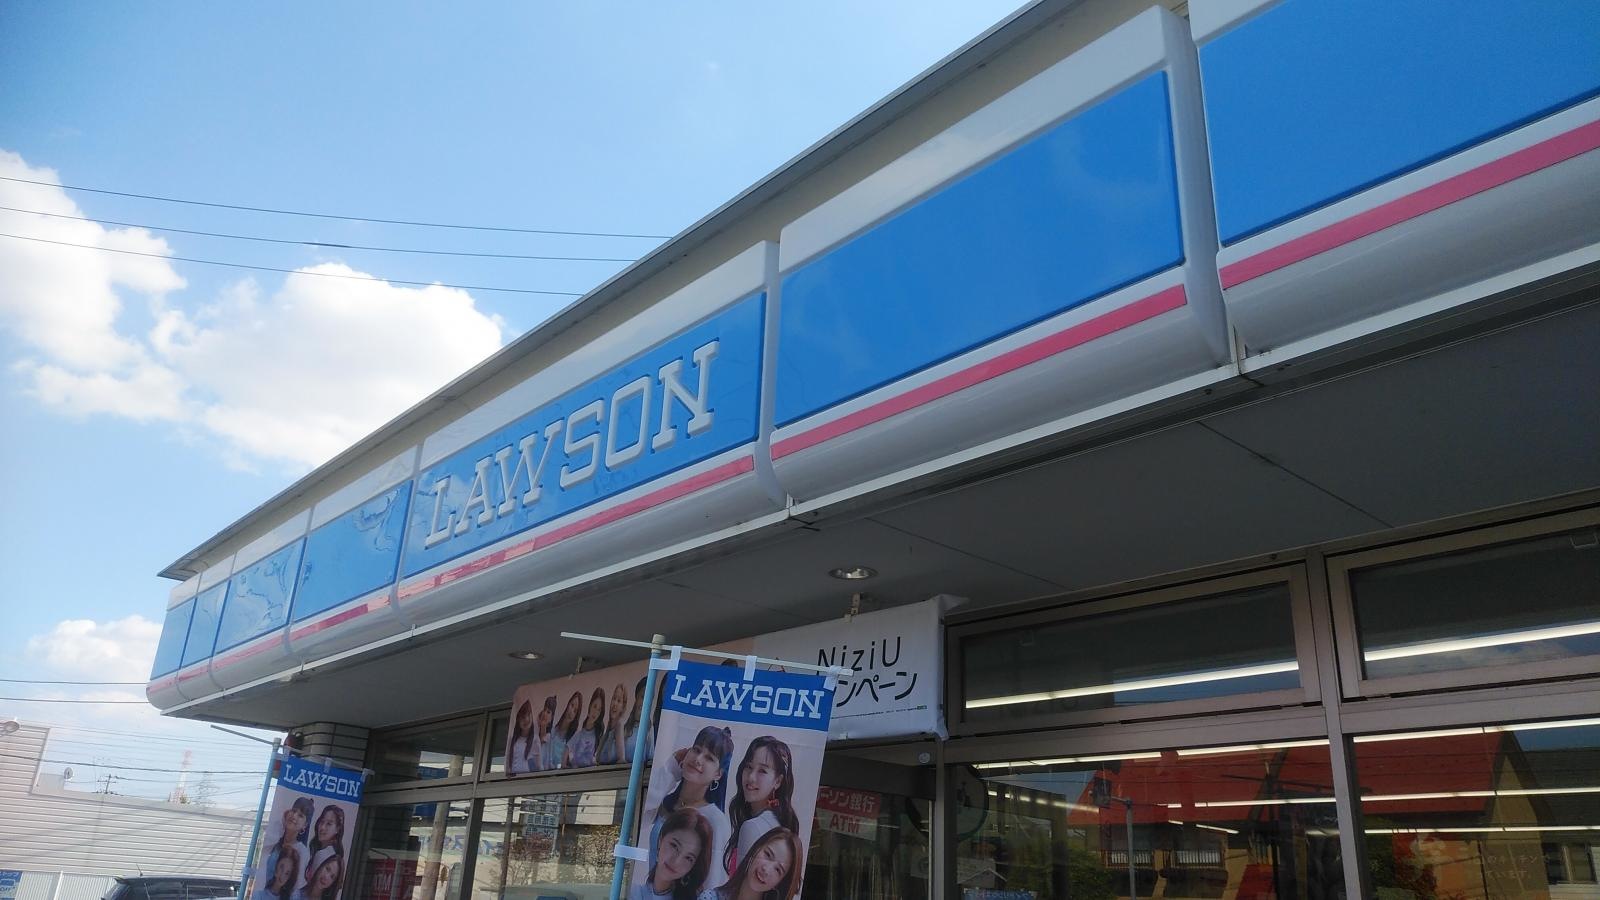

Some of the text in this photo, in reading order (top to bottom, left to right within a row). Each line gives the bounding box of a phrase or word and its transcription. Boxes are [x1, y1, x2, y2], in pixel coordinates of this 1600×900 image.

[425, 338, 720, 549] LAWSON
[817, 636, 902, 672] NiziU
[670, 673, 826, 720] LAWSON
[834, 671, 918, 708] ンペーン
[283, 763, 361, 798] LAWSON
[830, 814, 861, 833] ATM
